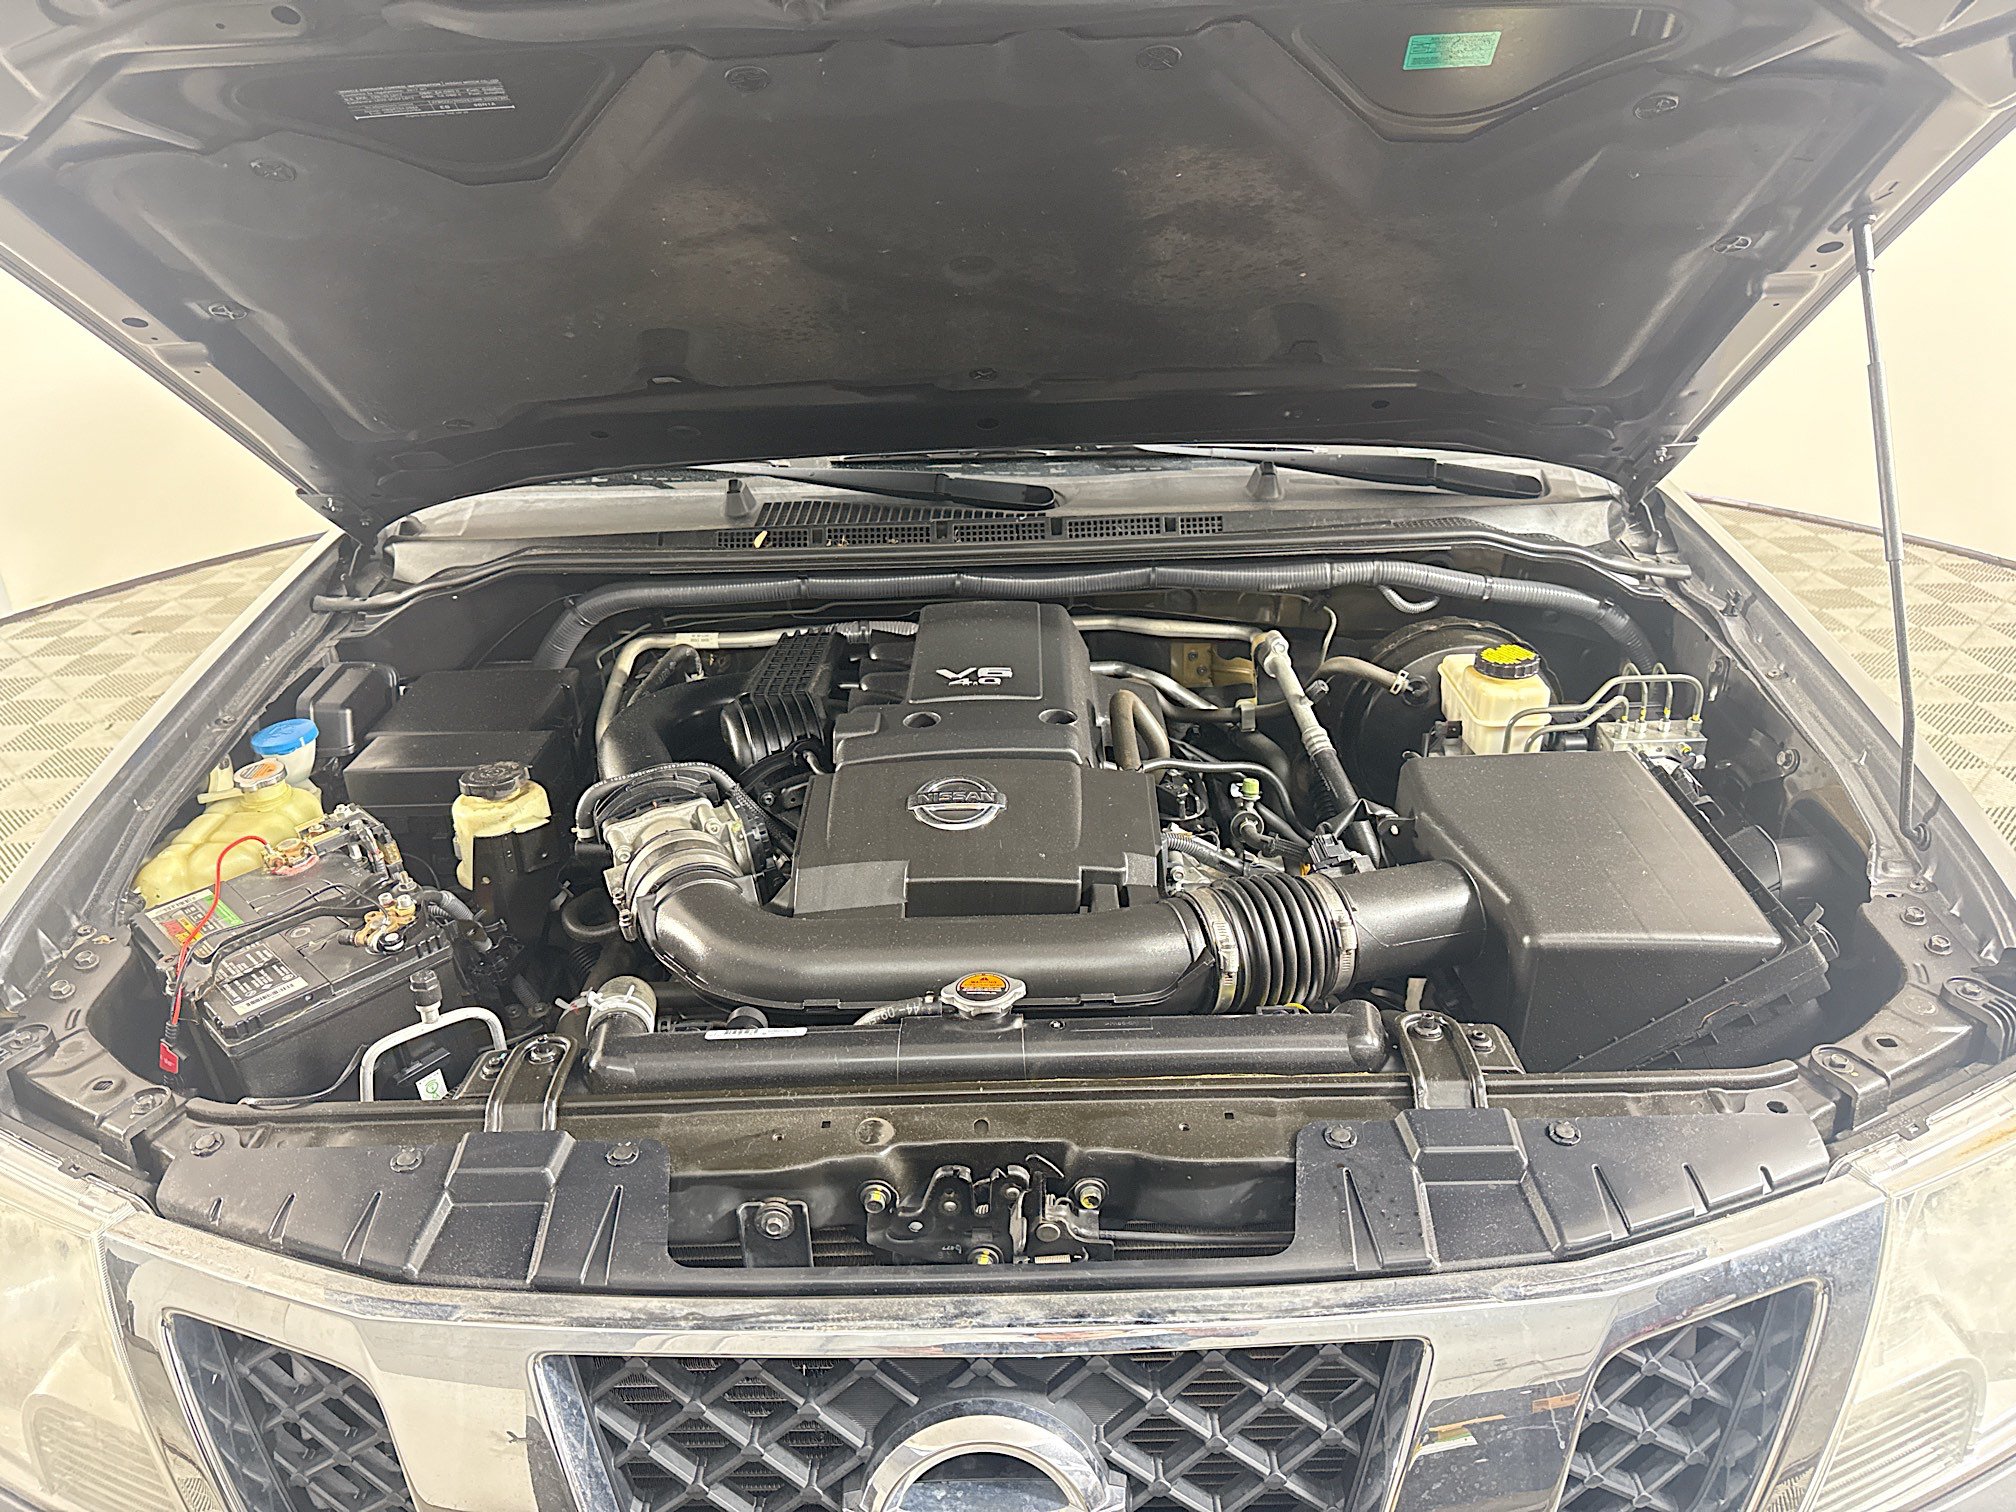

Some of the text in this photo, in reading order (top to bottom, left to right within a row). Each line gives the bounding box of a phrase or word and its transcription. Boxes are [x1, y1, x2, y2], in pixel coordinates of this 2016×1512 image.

[935, 666, 1013, 680] V6
[948, 677, 1002, 686] 4.0
[917, 792, 995, 804] NISSAN
